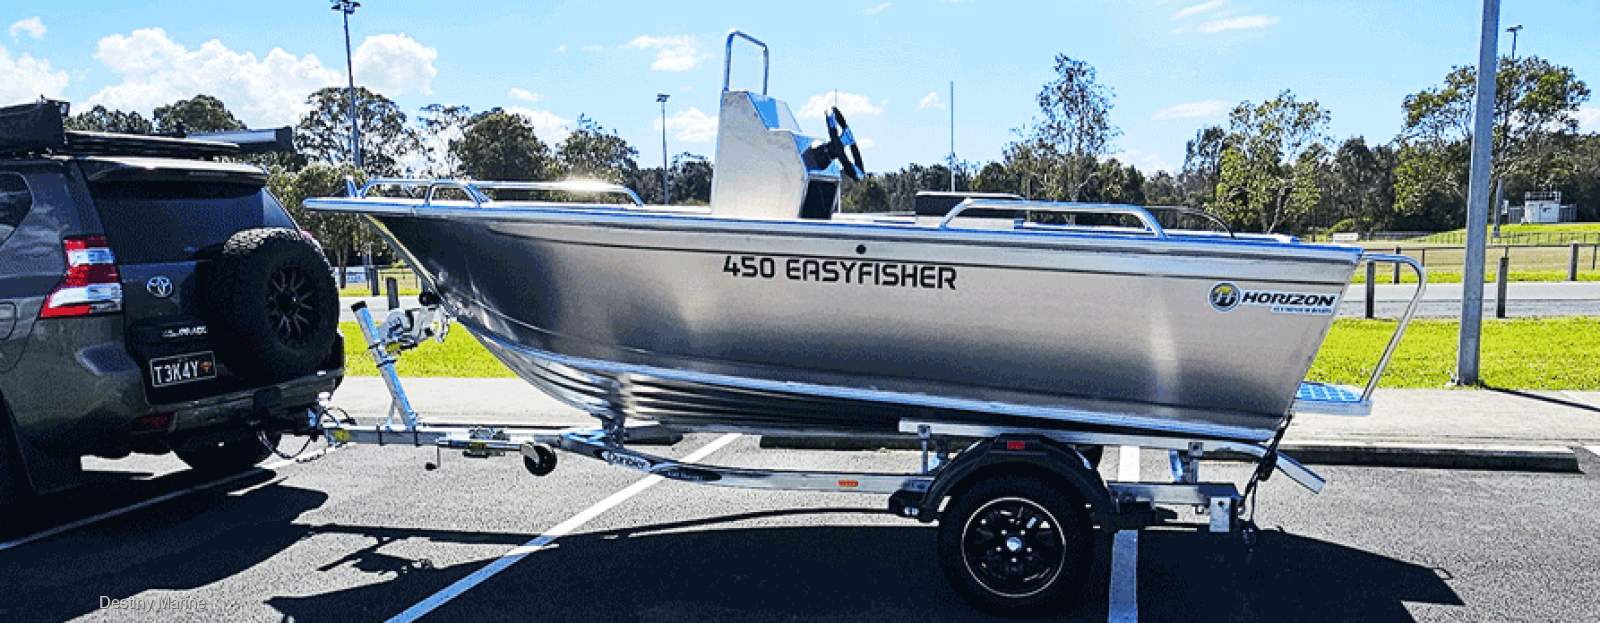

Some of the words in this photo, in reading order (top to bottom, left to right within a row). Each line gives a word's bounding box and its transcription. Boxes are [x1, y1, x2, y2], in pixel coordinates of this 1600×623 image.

[722, 255, 775, 279] 450
[786, 259, 957, 290] EASYFISHER
[1241, 291, 1336, 306] HORIZON
[153, 361, 198, 384] T3K4Y
